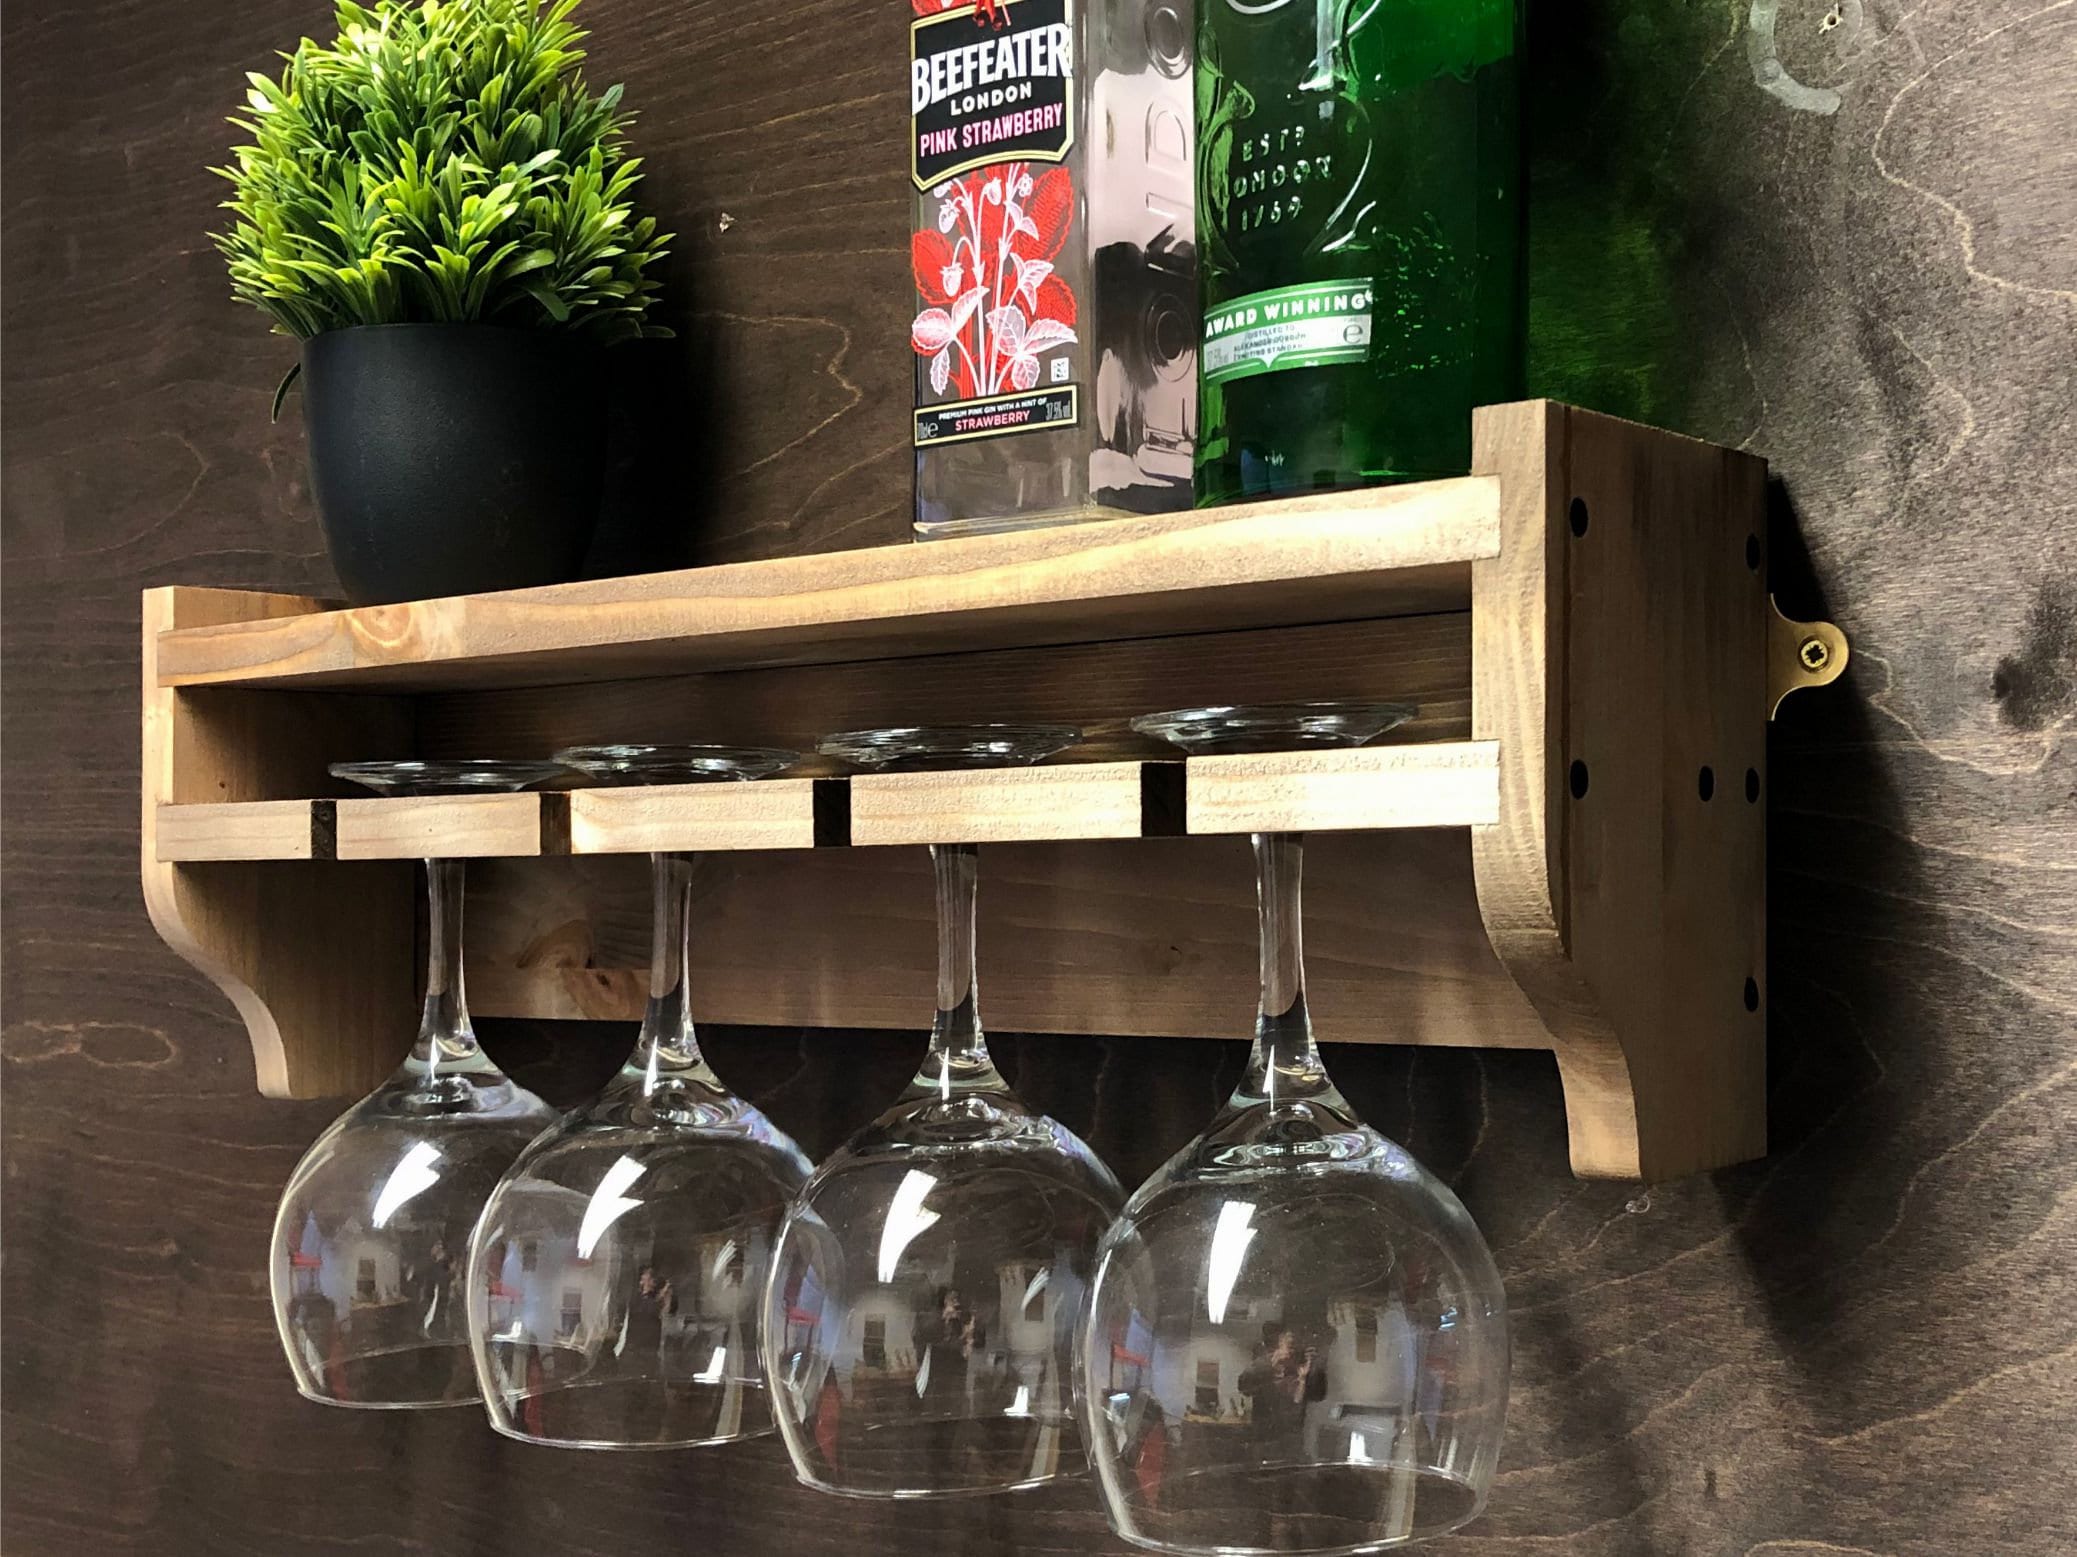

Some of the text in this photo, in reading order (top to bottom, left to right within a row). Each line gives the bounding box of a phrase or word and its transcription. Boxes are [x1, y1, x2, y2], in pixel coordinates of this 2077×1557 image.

[912, 23, 1073, 117] BEEFEATER
[951, 81, 1032, 116] LONDON
[920, 103, 1063, 157] PINK STRAWBERRY
[1205, 293, 1366, 339] AWARD WINNING
[938, 410, 967, 420] PREMIUM
[983, 406, 996, 414] GIN
[997, 402, 1014, 411] WITH
[1037, 397, 1048, 406] OF
[955, 410, 1031, 431] STRAWBERRY
